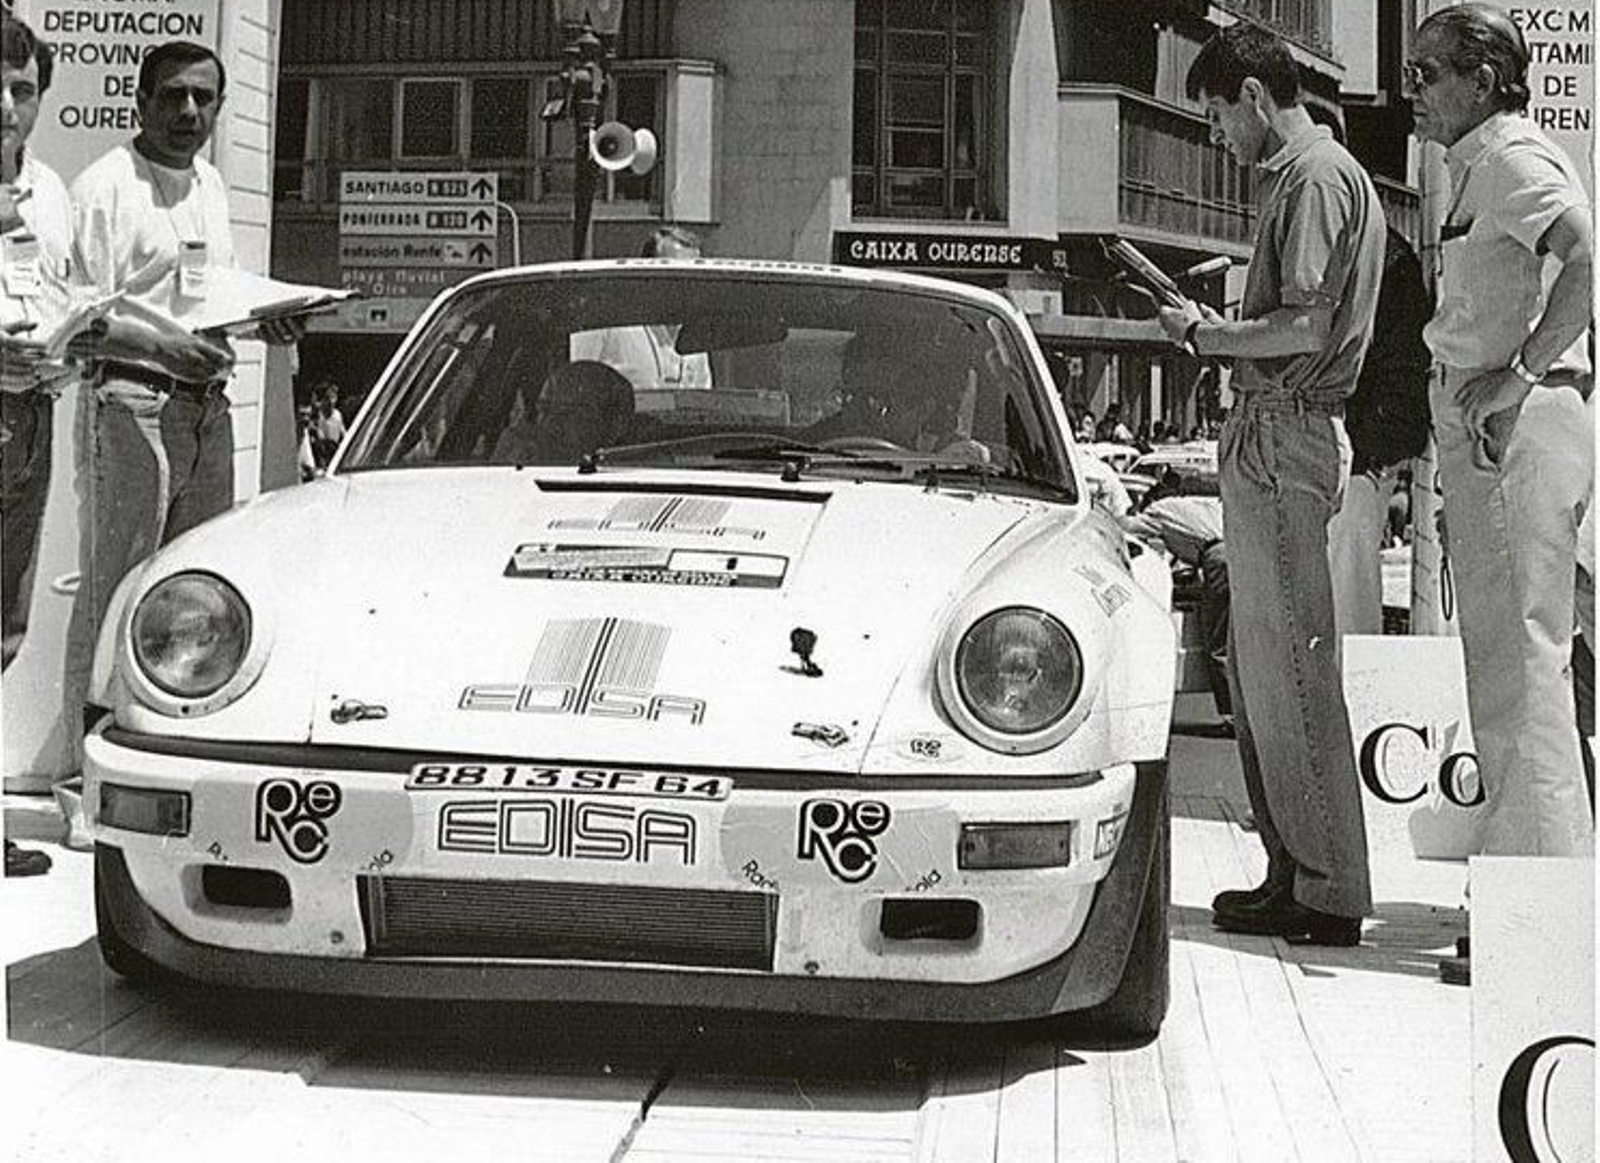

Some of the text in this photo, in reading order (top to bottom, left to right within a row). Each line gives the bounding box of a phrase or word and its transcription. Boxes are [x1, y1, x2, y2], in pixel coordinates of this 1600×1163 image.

[44, 10, 204, 36] DEPUTACION
[104, 75, 135, 97] DE
[1544, 76, 1577, 97] DE
[1534, 107, 1590, 131] REN
[346, 180, 425, 195] SANTIAGO
[851, 240, 1023, 264] CAIXA OURENSE
[458, 683, 706, 725] EDISA
[437, 797, 697, 865] EDISA
